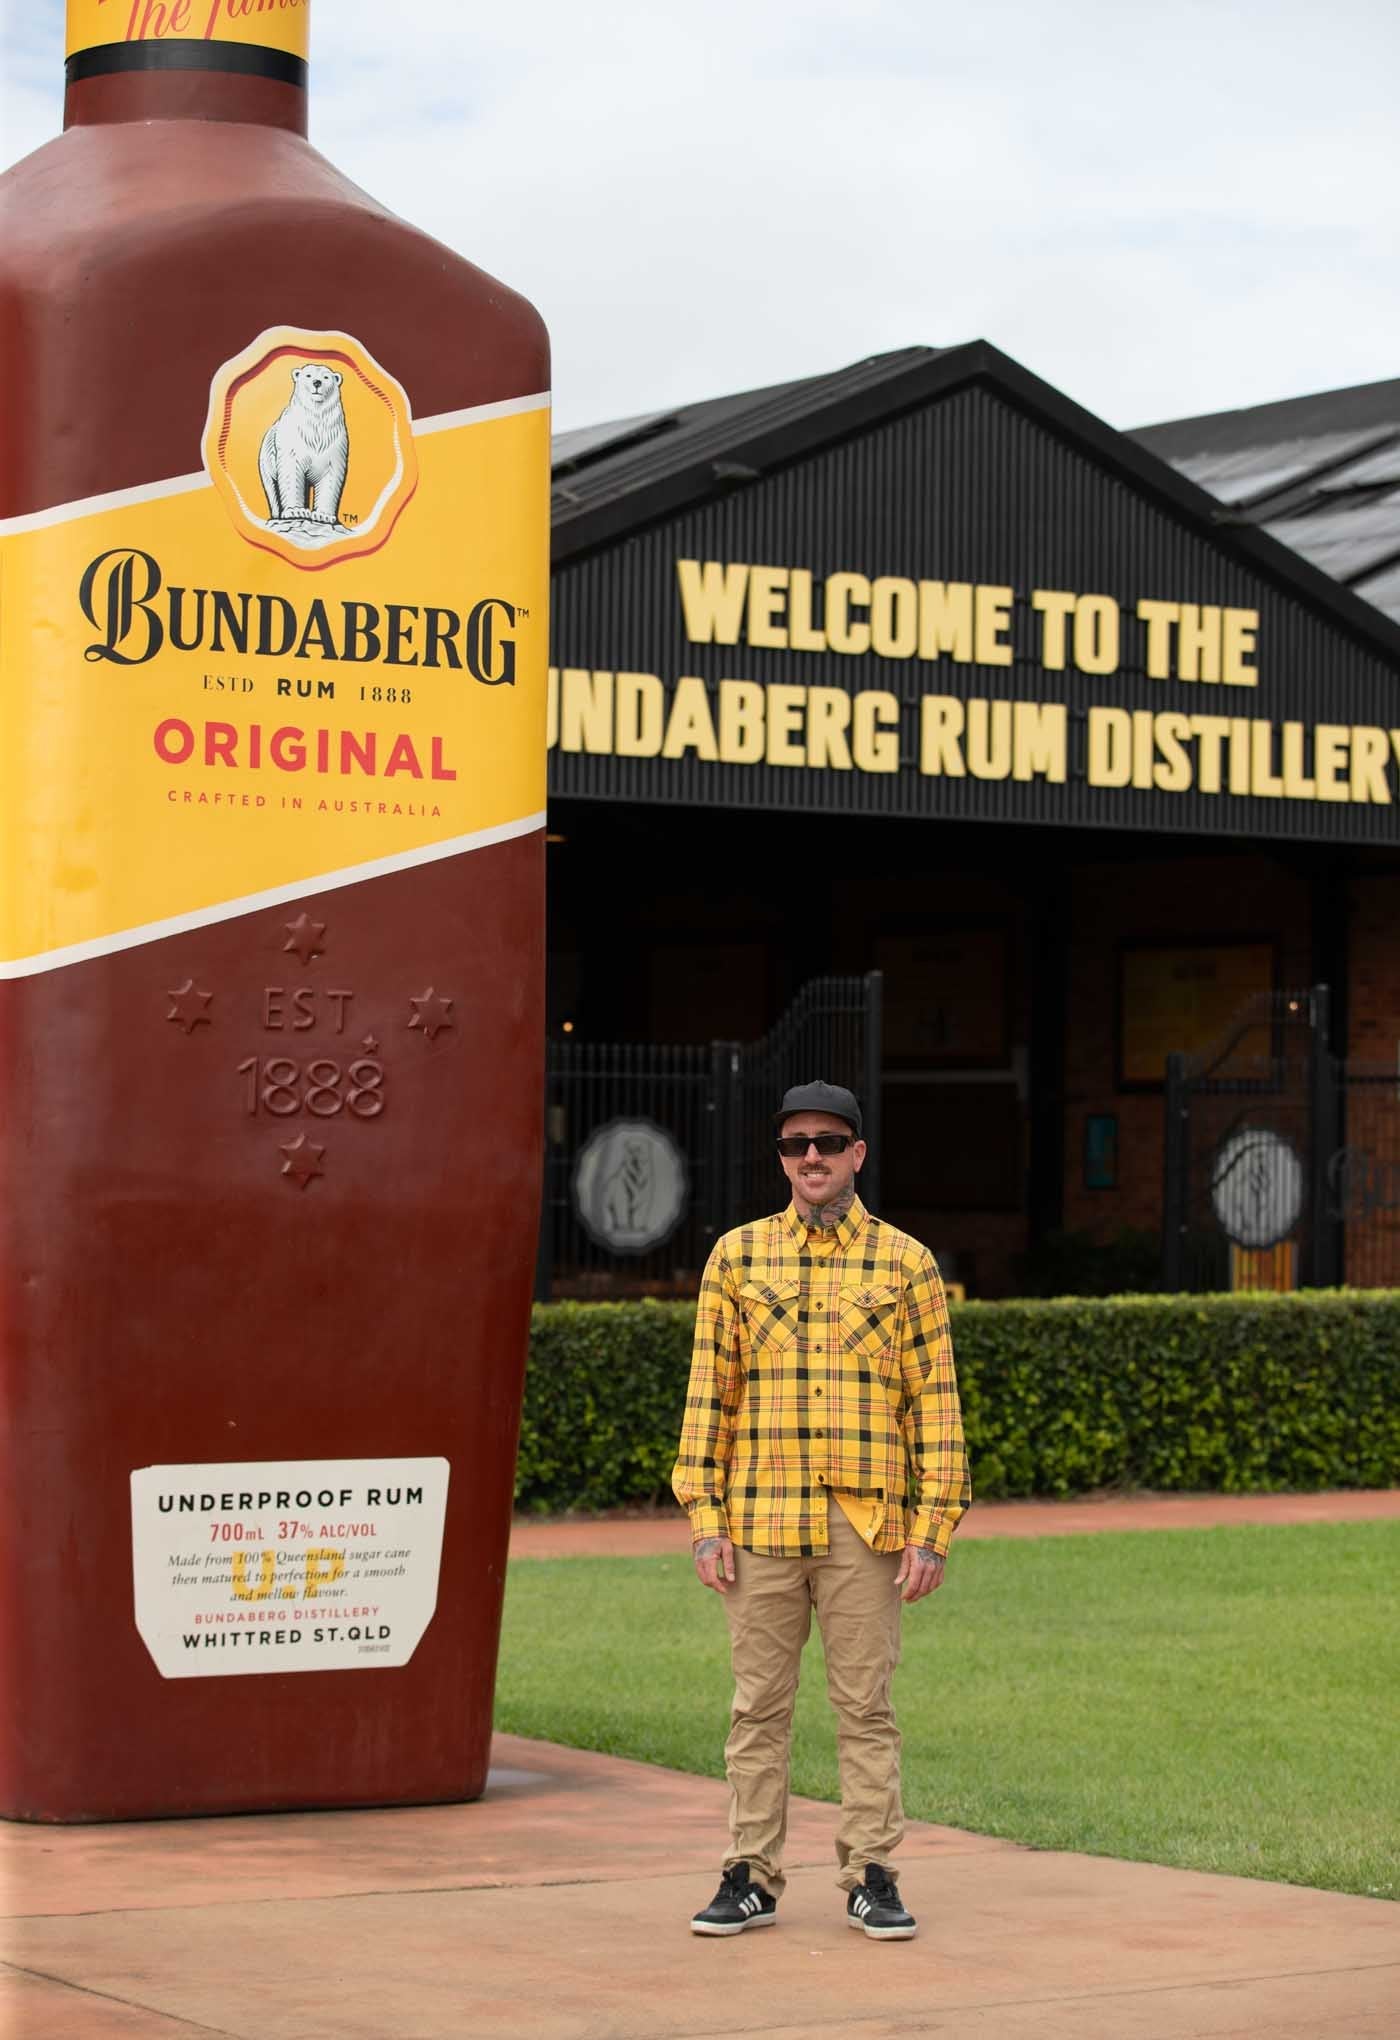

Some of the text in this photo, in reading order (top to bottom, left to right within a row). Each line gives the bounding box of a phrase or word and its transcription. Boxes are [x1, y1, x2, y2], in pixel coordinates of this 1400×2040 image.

[343, 513, 358, 524] TM
[79, 548, 516, 687] BUNDABERG
[677, 559, 1260, 688] WELCOME TO THE
[202, 674, 412, 704] ESTD RUM 1888
[154, 718, 457, 781] ORIGINAL
[920, 694, 1068, 784] RUM
[1087, 706, 1400, 805] DISTILLER
[168, 789, 441, 817] CRAFTED IN AUSTRALIA
[263, 986, 353, 1034] EST
[237, 1056, 385, 1119] 1888
[158, 1487, 424, 1513] UNDERPROOF RUM
[210, 1521, 377, 1542] 700mL 37% ALC/VOL
[168, 1548, 411, 1568] Made from 100% Queensland sugar cane
[172, 1564, 406, 1585] then matured to perfection for a smooth
[229, 1584, 349, 1601] and mellow flavour.
[195, 1606, 380, 1625] BUNDABERG DISTILLERY
[183, 1630, 302, 1649] WHITTRED
